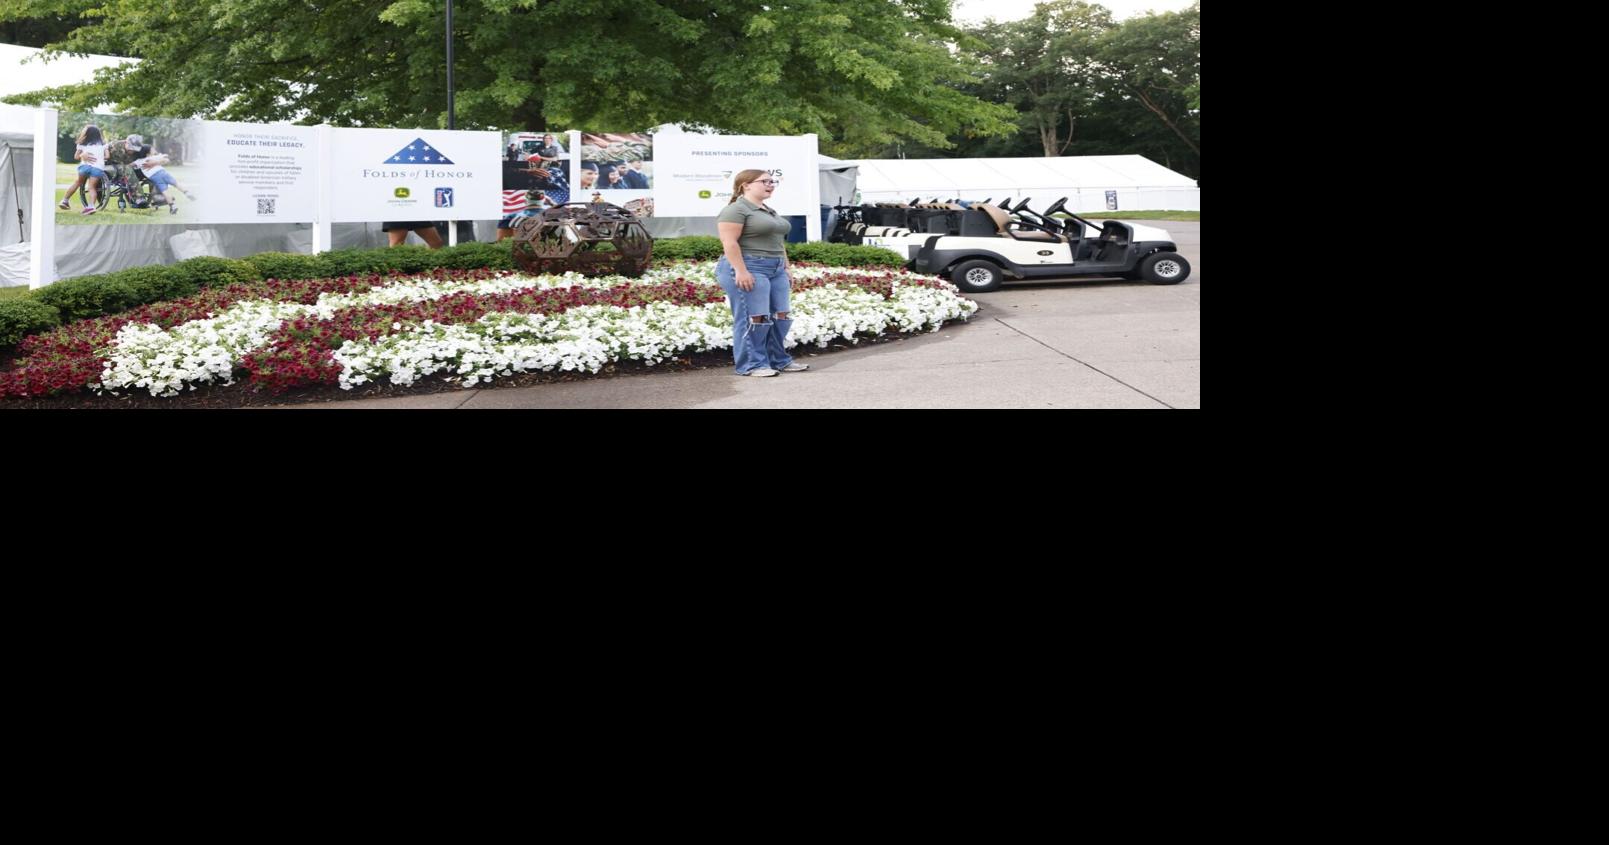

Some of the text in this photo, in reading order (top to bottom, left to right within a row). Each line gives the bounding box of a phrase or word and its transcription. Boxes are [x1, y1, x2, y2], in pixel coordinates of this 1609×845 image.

[362, 169, 473, 180] FOLDS of HONOR
